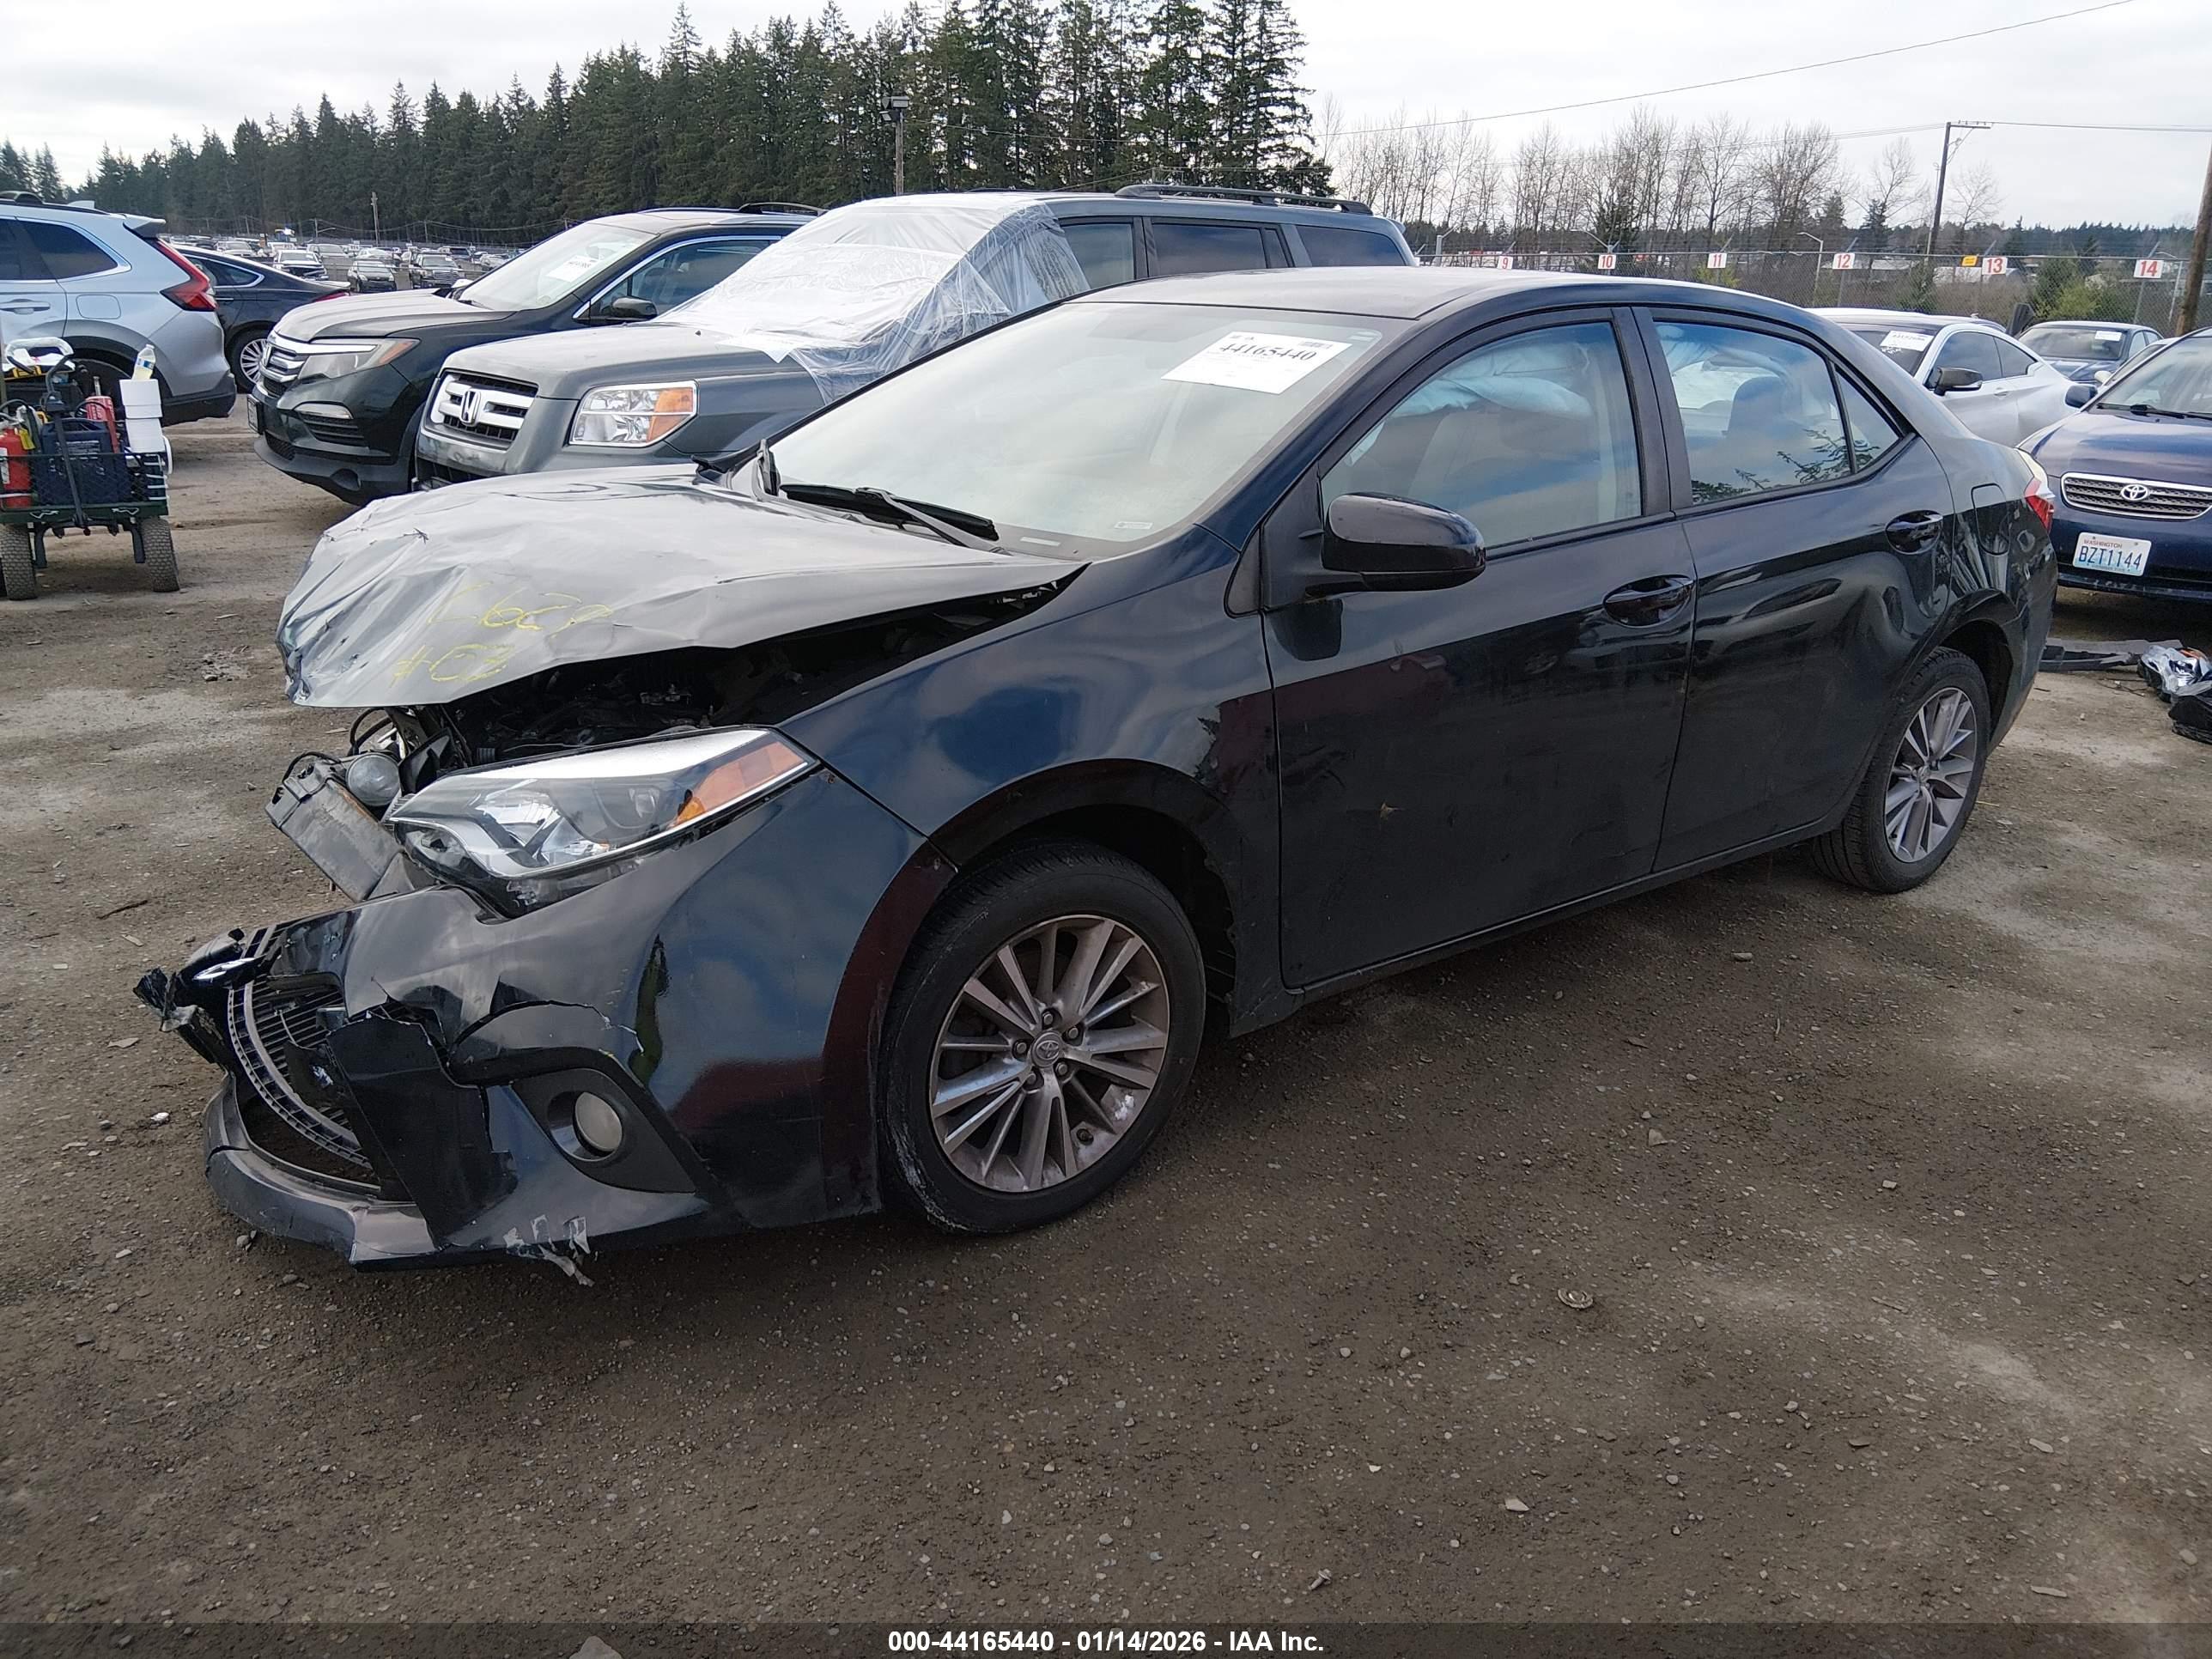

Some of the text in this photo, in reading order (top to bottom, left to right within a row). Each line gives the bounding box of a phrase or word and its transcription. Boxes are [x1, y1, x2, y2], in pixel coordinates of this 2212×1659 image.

[1502, 257, 1509, 270] 9
[1601, 255, 1613, 268] 10
[1712, 253, 1723, 267] 11
[1837, 253, 1850, 269] 12
[1986, 258, 2003, 273] 13
[2140, 260, 2159, 276] 14
[1219, 343, 1317, 361] 44165440
[2084, 539, 2123, 549] WASHINGTON
[2079, 545, 2142, 569] BZT1144
